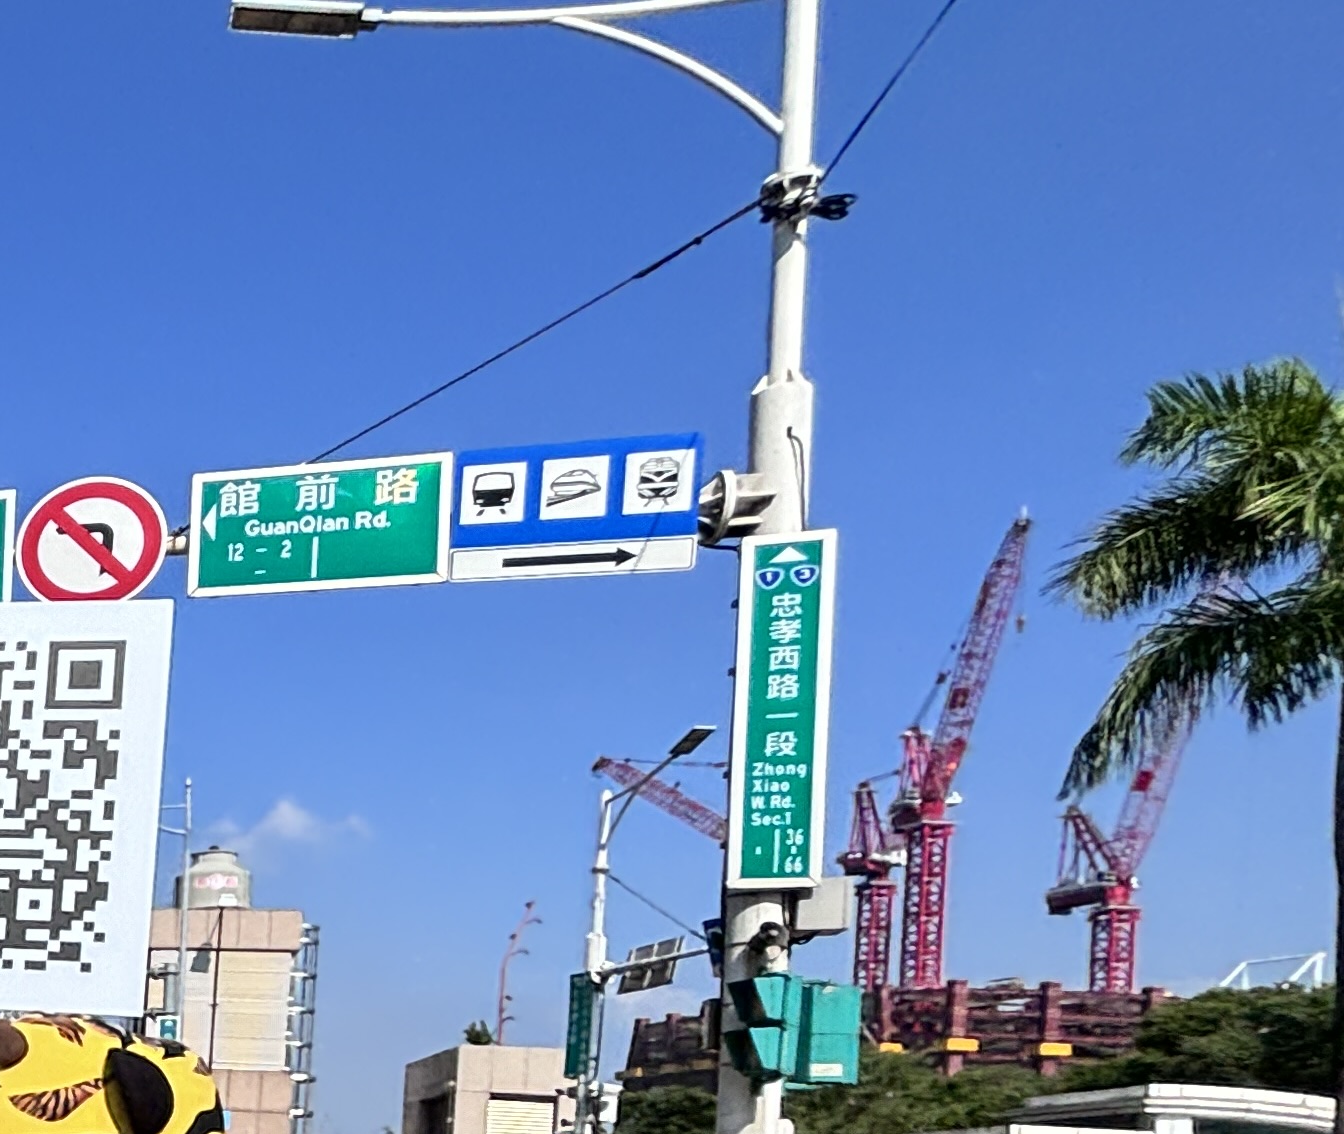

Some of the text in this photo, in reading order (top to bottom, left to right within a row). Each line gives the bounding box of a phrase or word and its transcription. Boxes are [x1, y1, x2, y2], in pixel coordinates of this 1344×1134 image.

[219, 468, 419, 518] 館前路
[355, 510, 391, 530] Rd.
[228, 542, 244, 562] 12
[765, 592, 803, 757] 忠孝西路一段
[752, 762, 807, 778] Zhong
[752, 779, 790, 792] Xiao
[770, 795, 795, 808] Rd.
[785, 828, 804, 845] 36
[784, 856, 803, 873] 66
